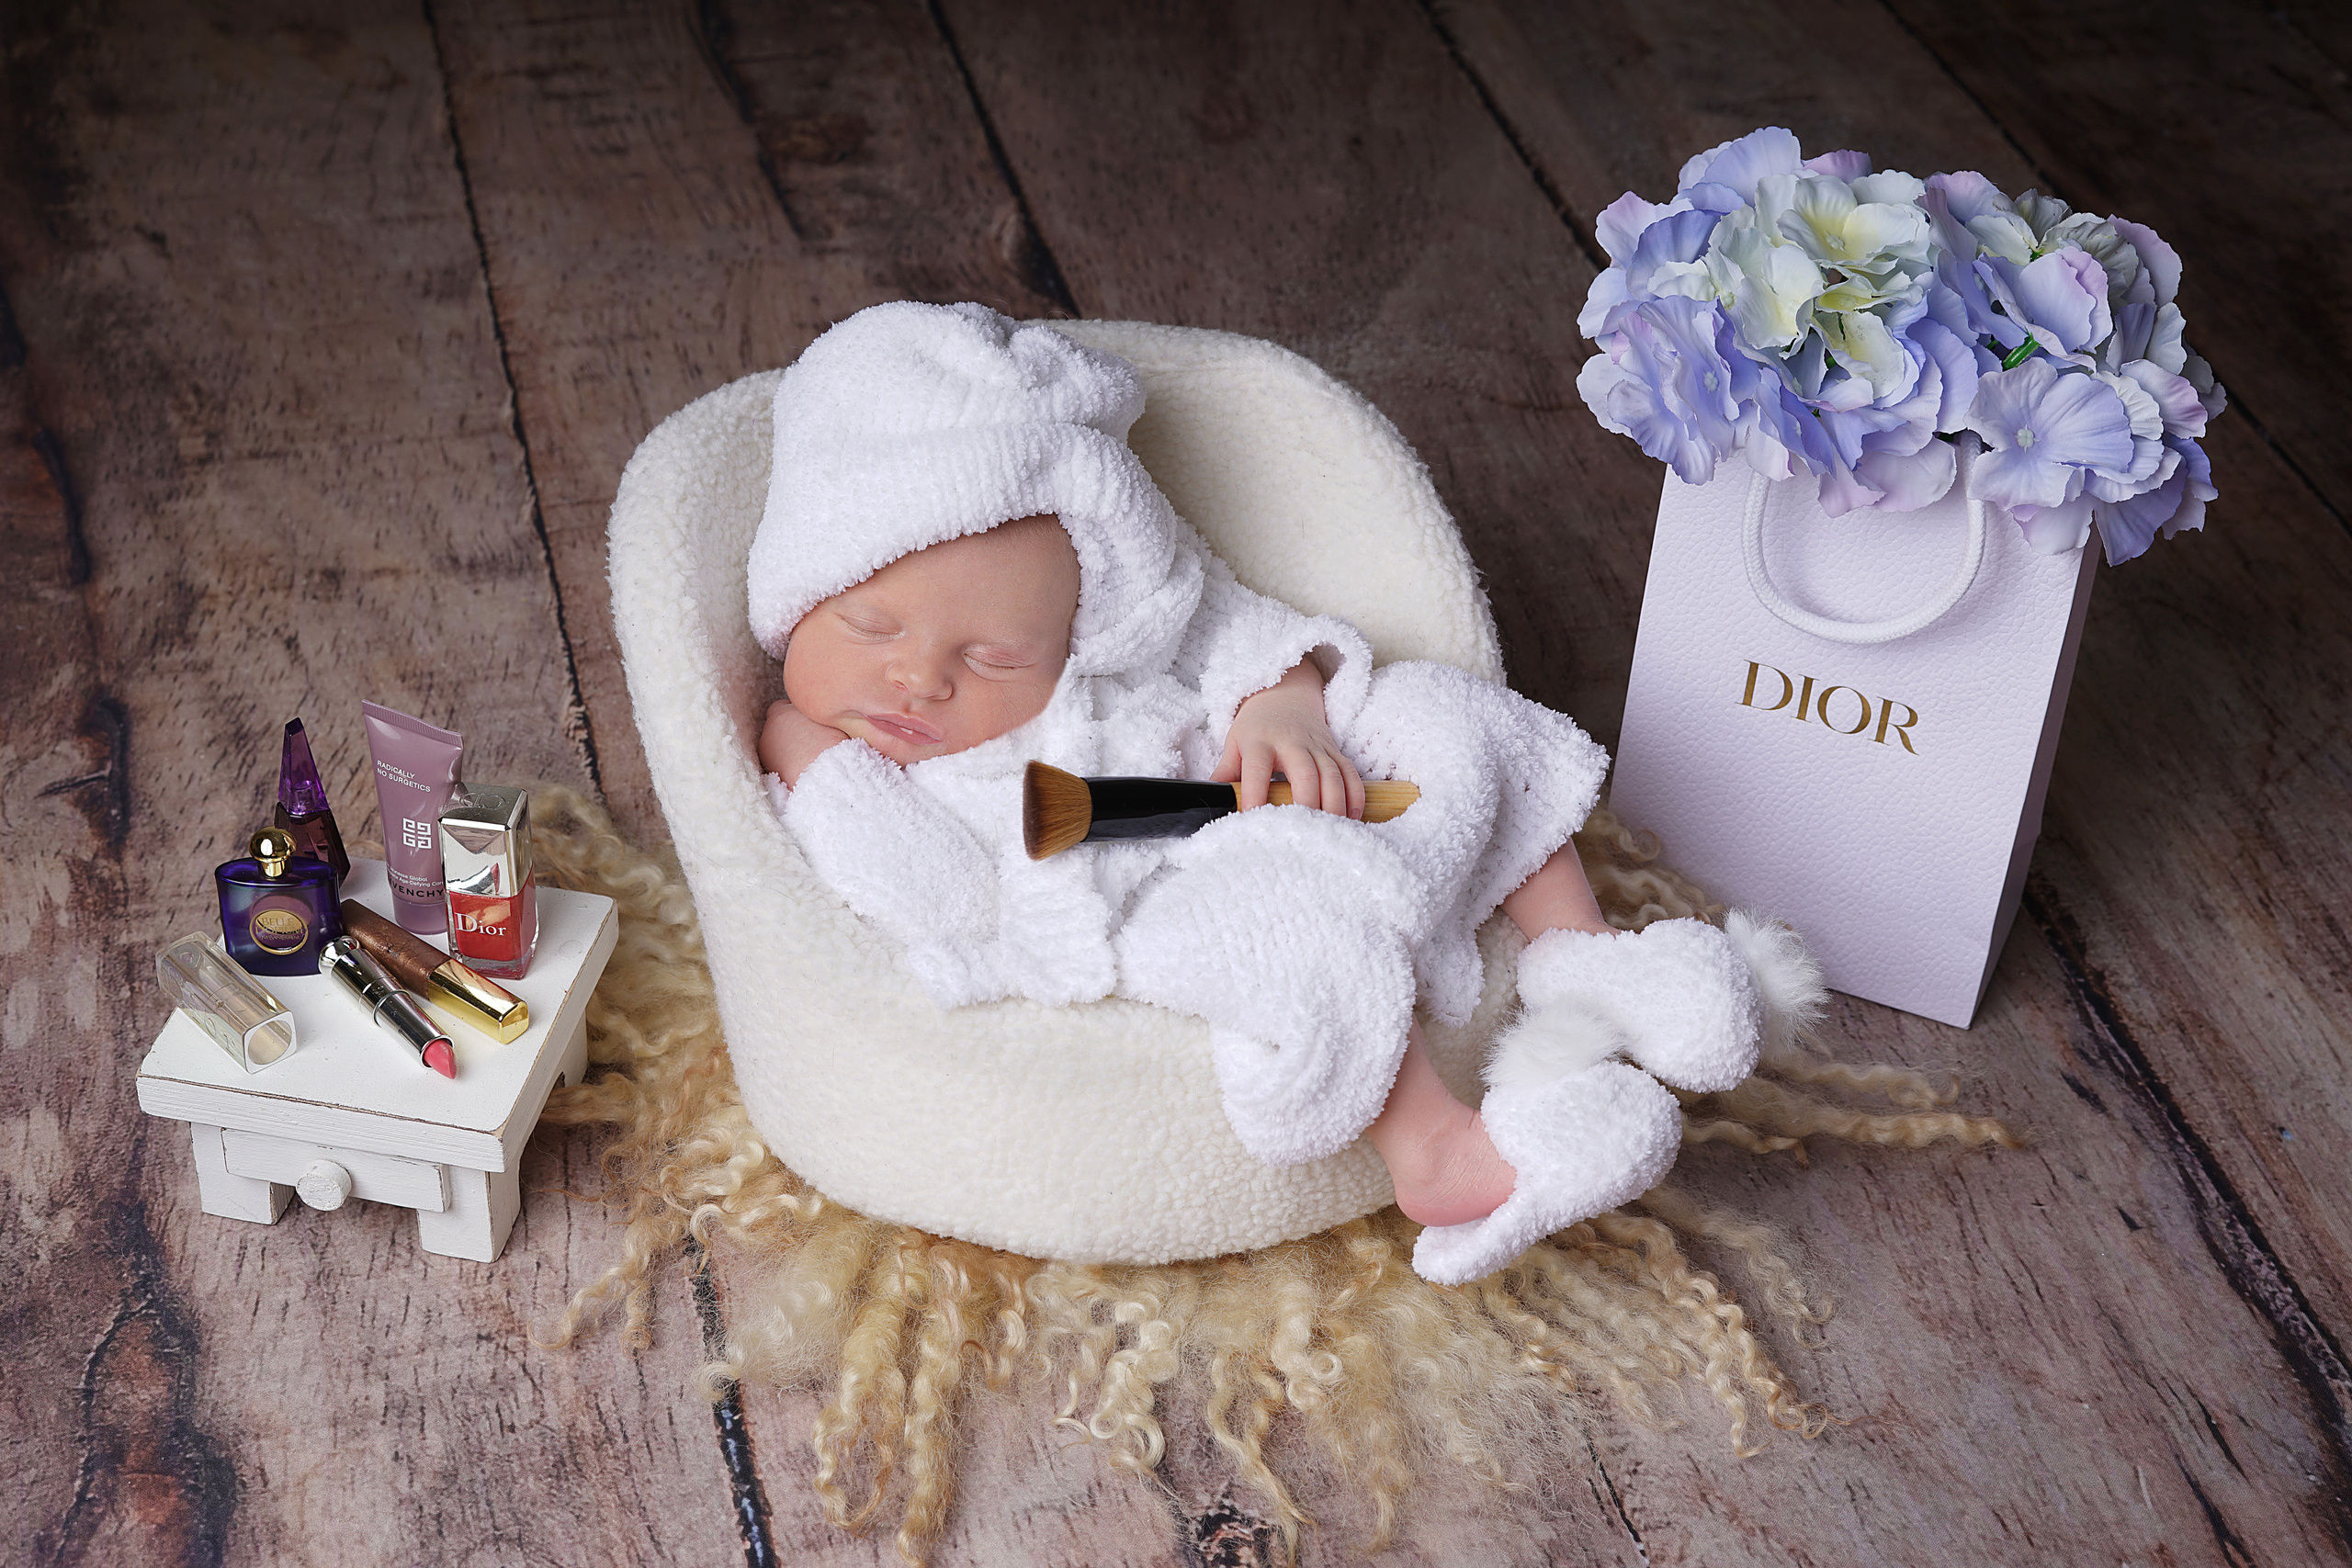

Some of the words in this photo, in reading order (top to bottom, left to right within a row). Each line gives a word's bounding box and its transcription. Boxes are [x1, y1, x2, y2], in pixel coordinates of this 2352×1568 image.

[1735, 659, 1919, 756] DIOR
[377, 760, 415, 780] RADICALLY
[377, 767, 387, 777] NO
[388, 773, 431, 793] SURGETICS
[389, 878, 445, 897] IVENCHY
[262, 918, 294, 926] BELLE
[453, 911, 507, 936] Dior
